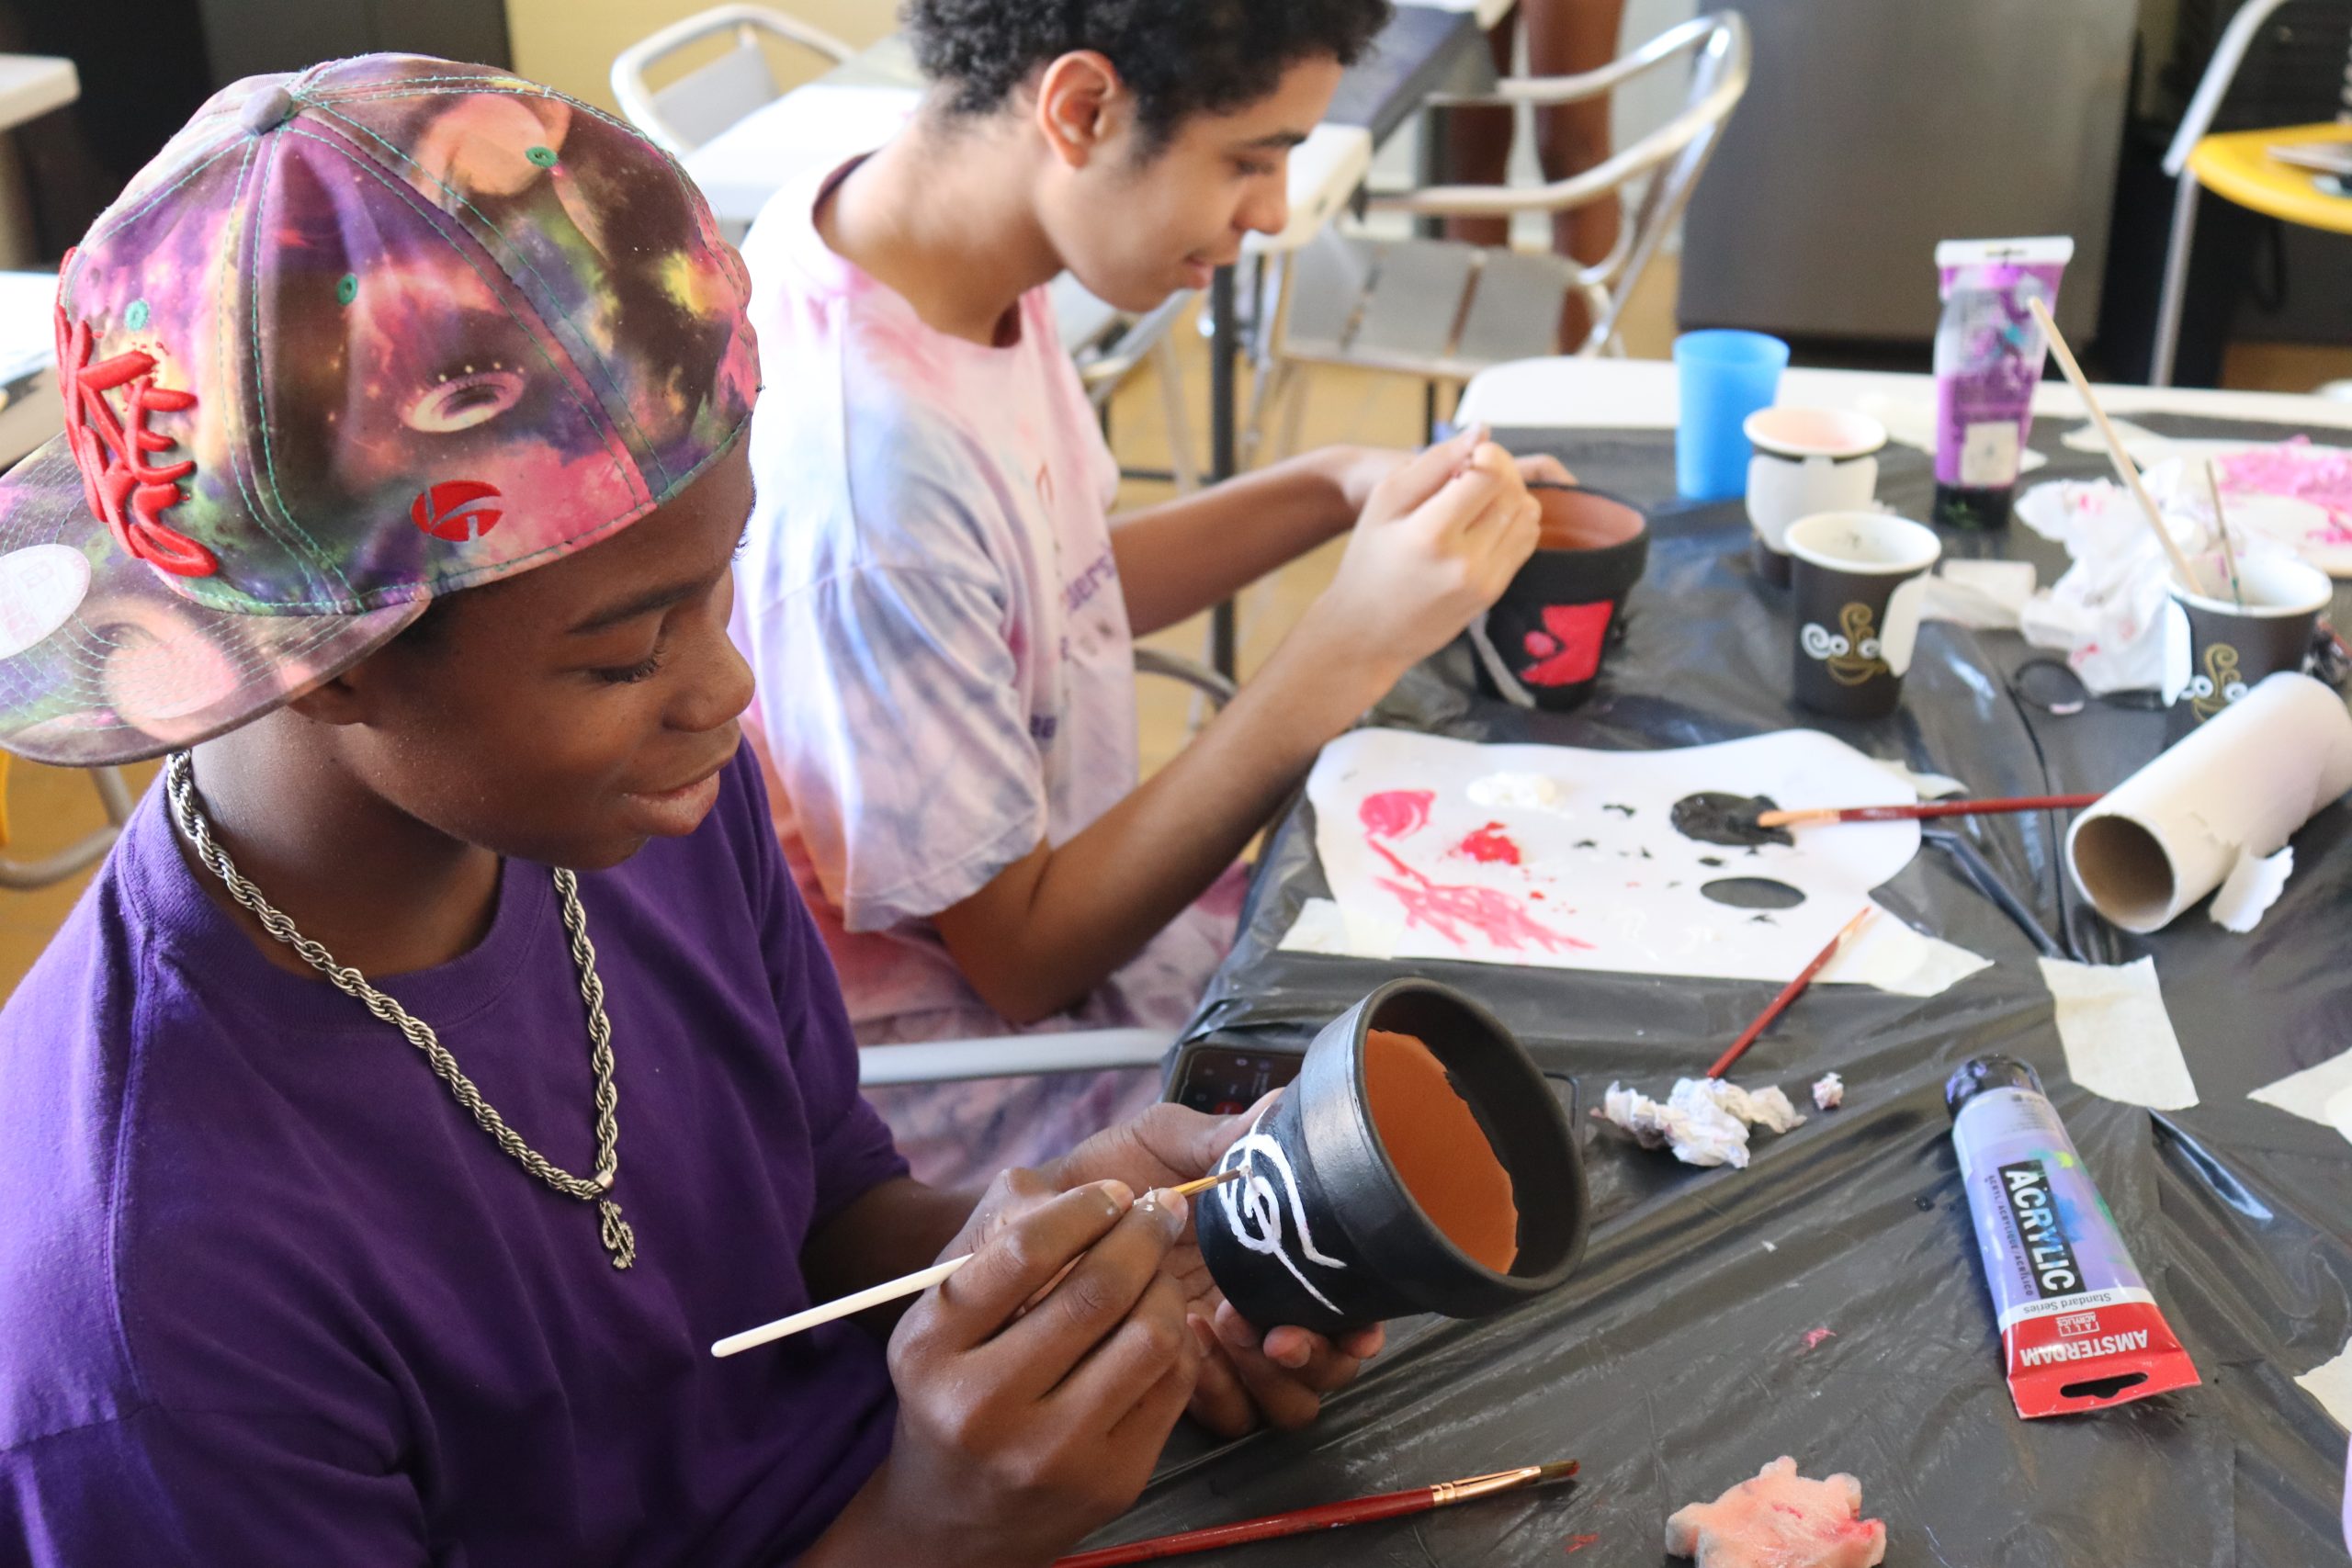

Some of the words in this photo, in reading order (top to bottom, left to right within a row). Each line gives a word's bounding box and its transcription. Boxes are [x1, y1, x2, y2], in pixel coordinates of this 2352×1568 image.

[2005, 1171, 2075, 1291] ACRYLIC
[2023, 1302, 2058, 1314] Series
[2061, 1292, 2111, 1308] Standard
[2019, 1329, 2147, 1367] AMSTERDAM
